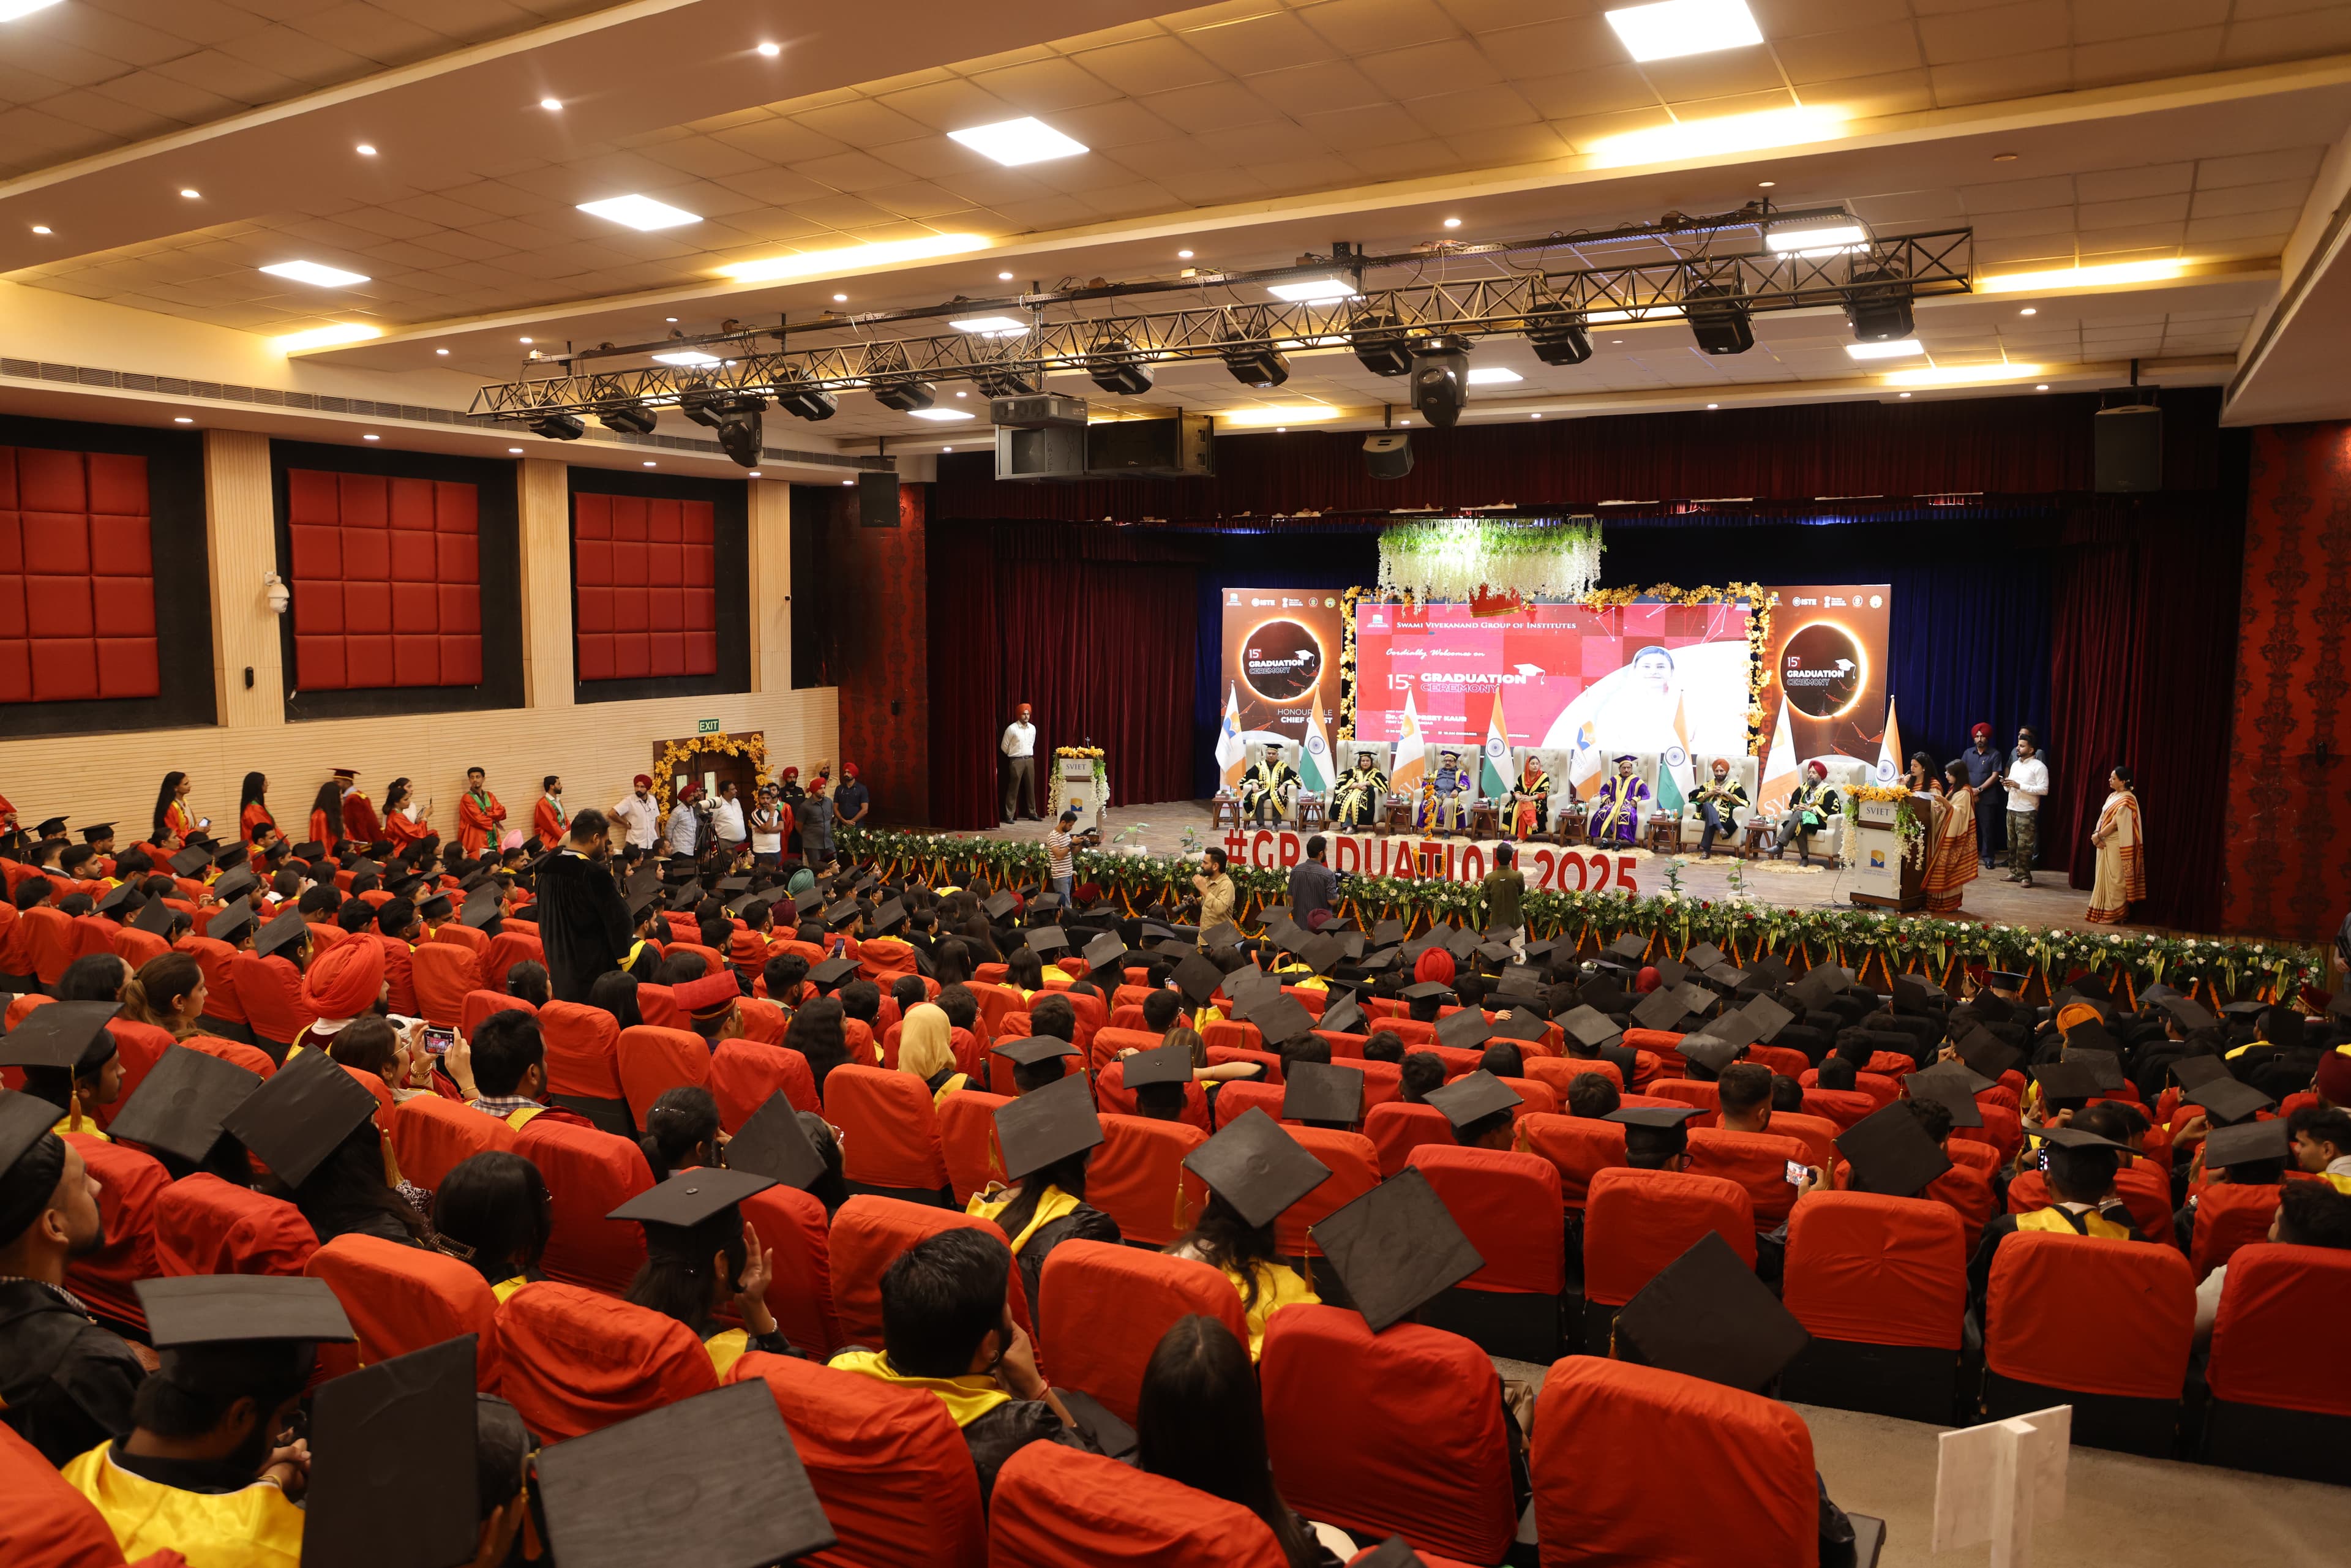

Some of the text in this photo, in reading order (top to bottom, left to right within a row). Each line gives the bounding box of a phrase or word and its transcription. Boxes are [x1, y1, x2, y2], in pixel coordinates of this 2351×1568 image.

[1386, 648, 1427, 659] Cordially
[1420, 673, 1526, 684] GRADUATION
[1420, 683, 1498, 693] CEREMONY
[699, 721, 718, 731] EXIT
[1867, 806, 1890, 816] SVIET
[1534, 849, 1637, 894] 2025
